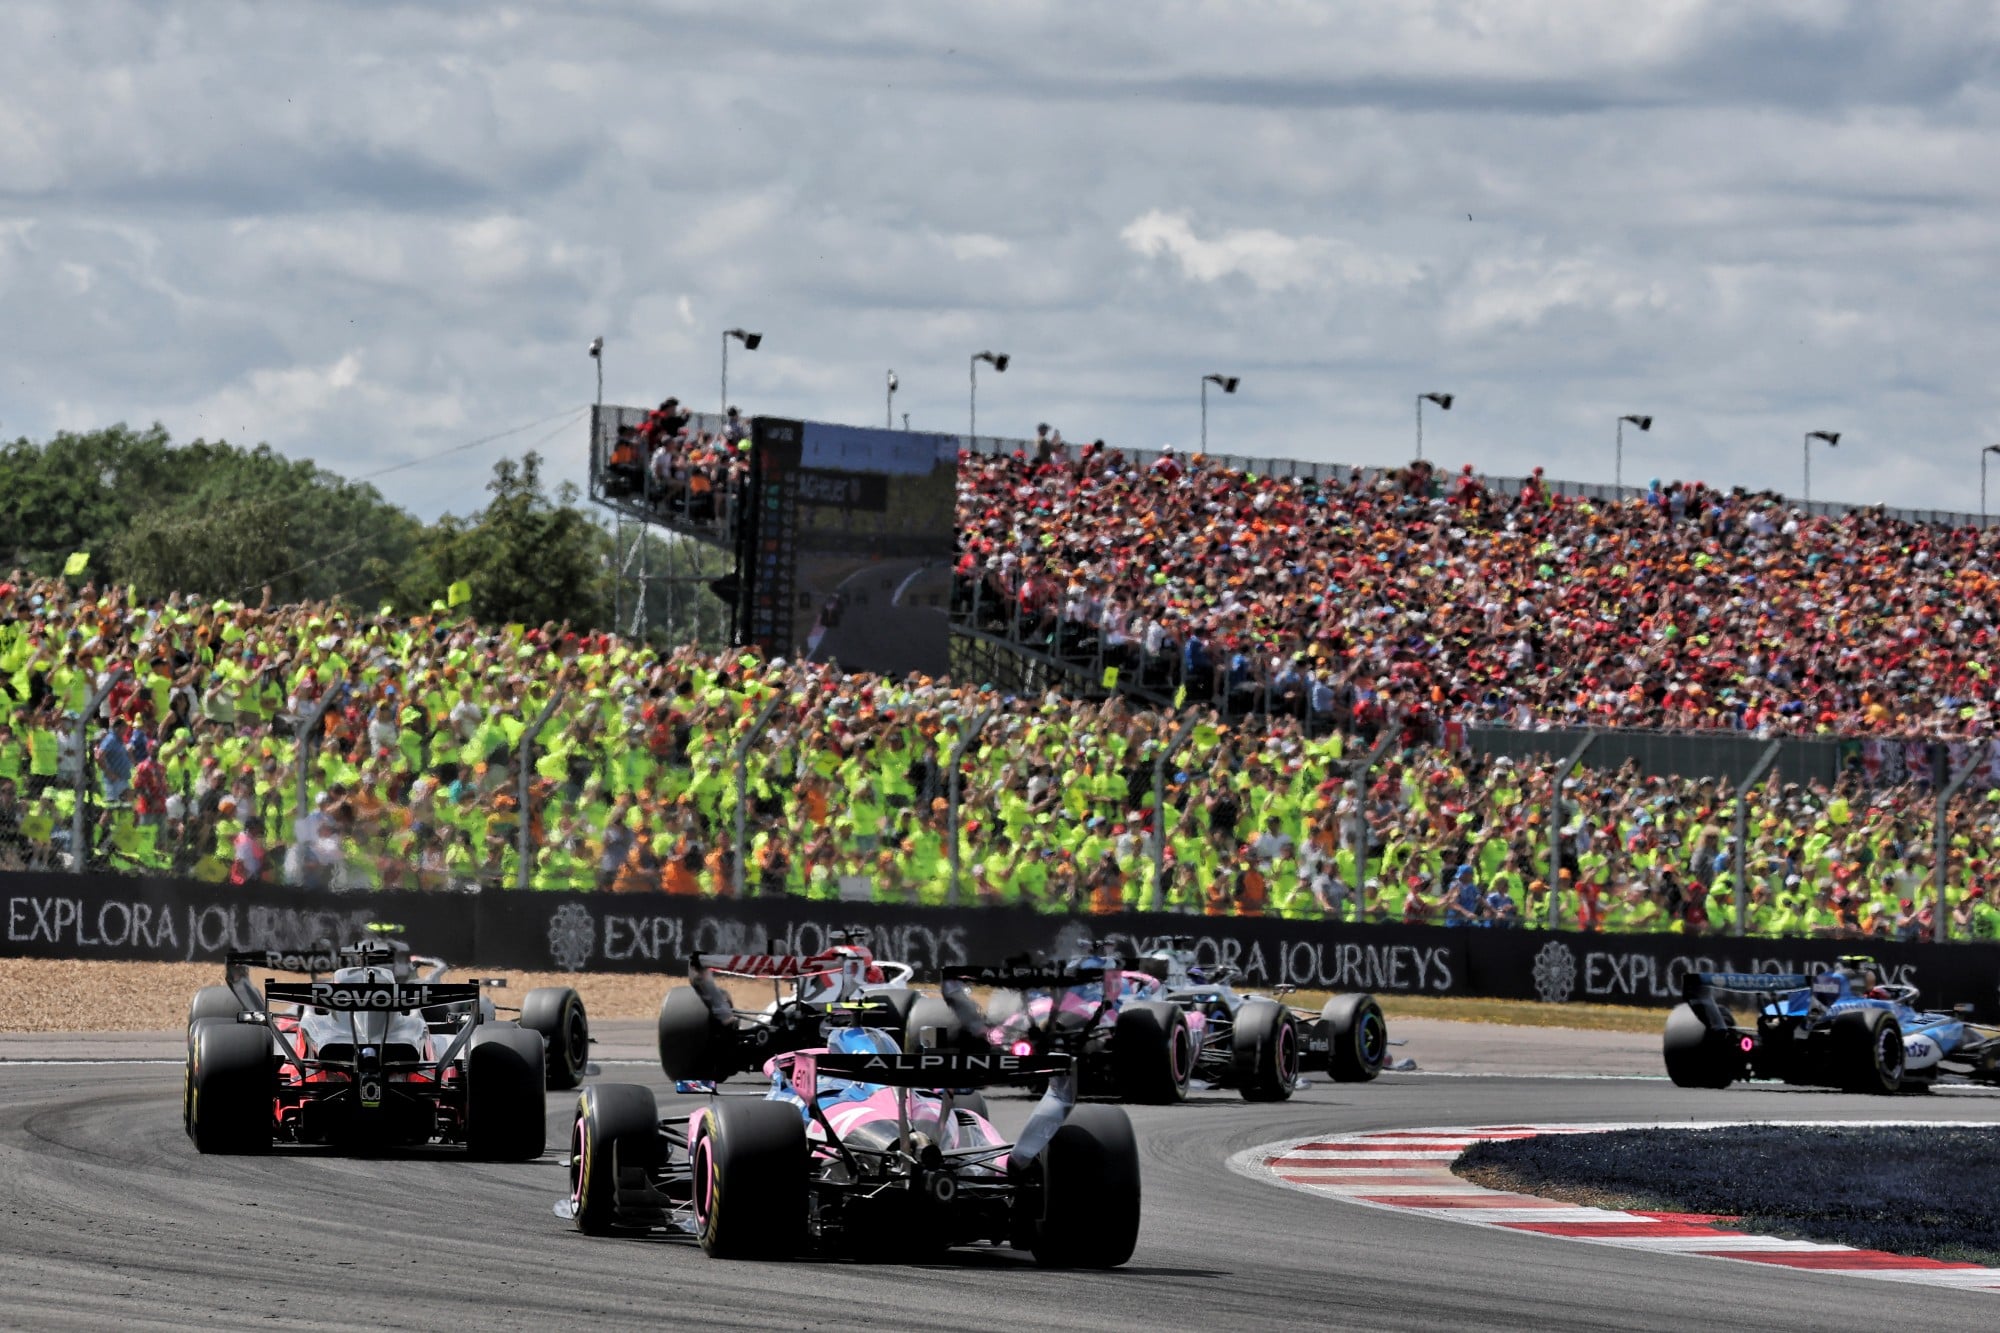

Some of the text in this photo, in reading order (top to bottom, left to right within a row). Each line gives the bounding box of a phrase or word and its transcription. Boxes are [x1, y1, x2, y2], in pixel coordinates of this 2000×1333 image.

[8, 896, 179, 948] EXPLORA
[786, 920, 968, 969] JORNEYS
[1280, 940, 1453, 990] JOURNEYS
[1585, 952, 1735, 997] EXPLO
[311, 983, 433, 1008] Revolut
[863, 1055, 1020, 1070] ALPINE
